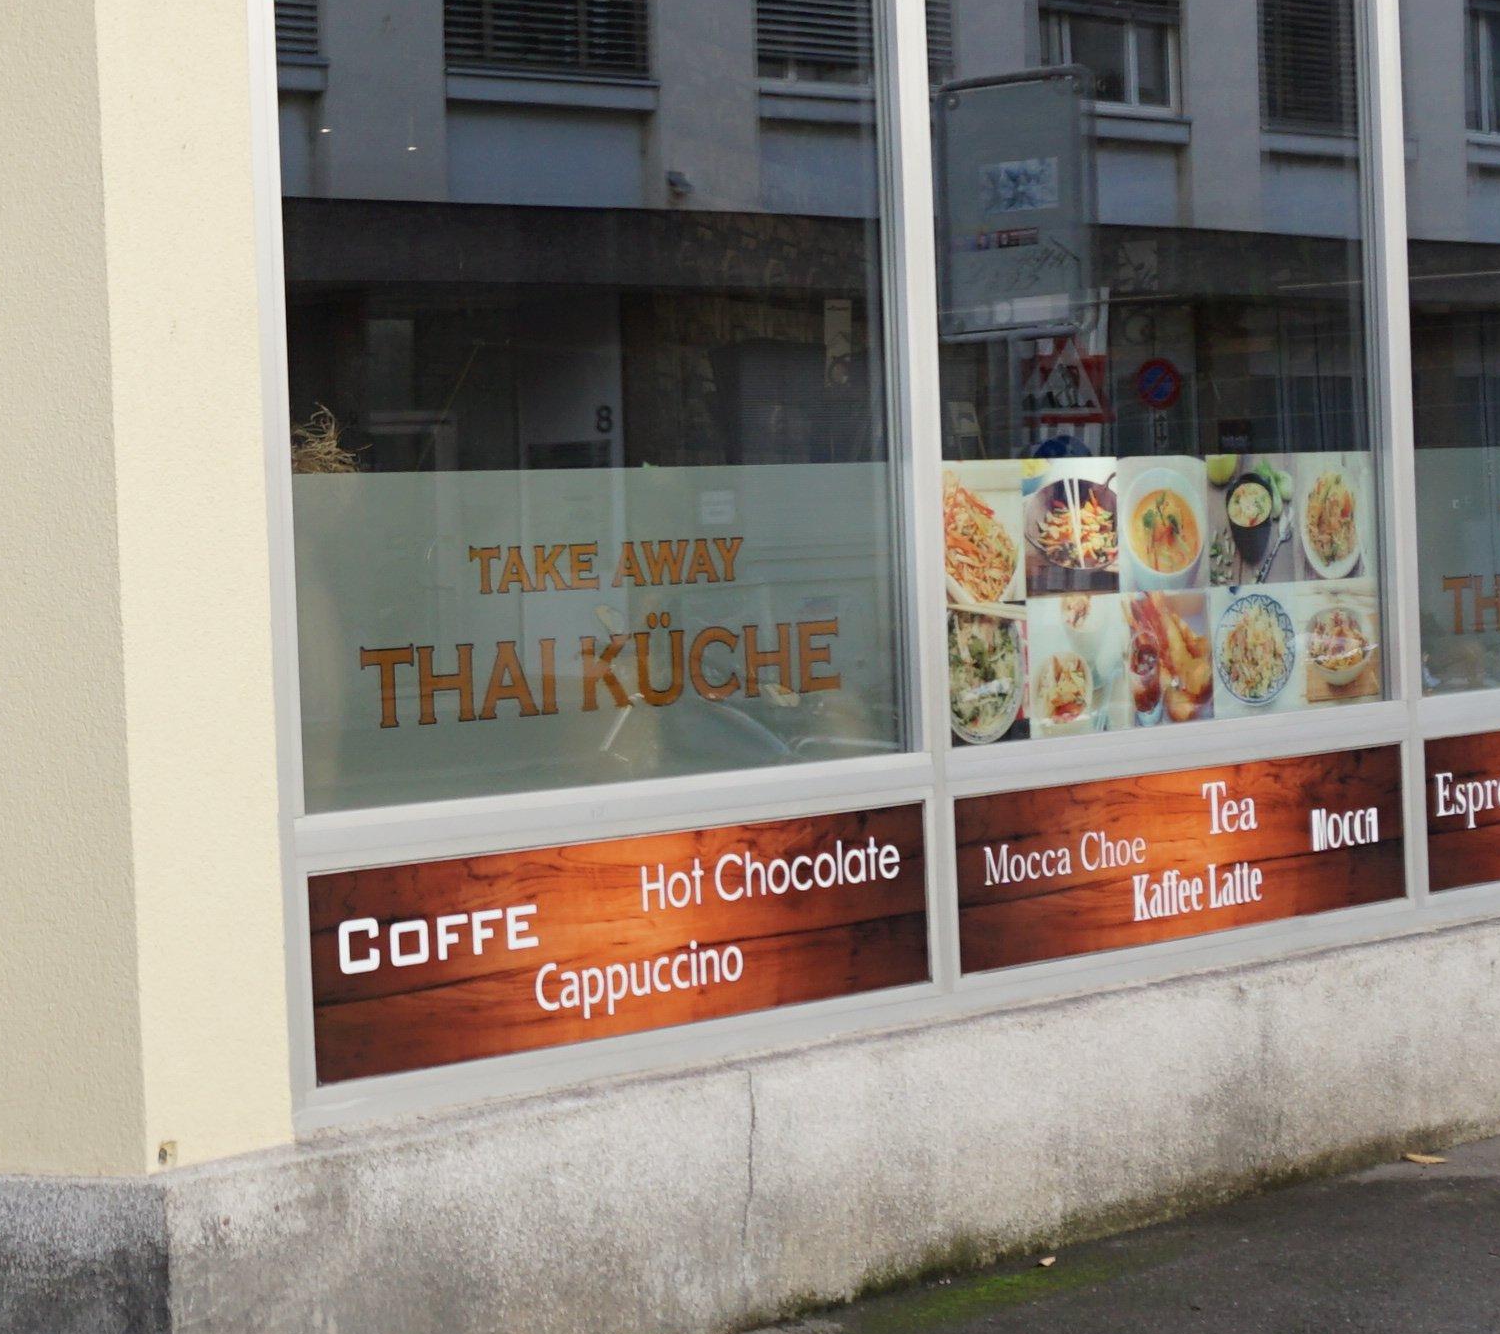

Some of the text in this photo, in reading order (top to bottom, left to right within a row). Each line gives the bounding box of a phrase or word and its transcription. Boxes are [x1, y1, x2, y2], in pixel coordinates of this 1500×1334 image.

[468, 536, 744, 595] TAKE AWAY
[360, 611, 842, 729] THAI KÜCHE
[1202, 780, 1258, 836] Tea
[639, 835, 901, 913] Hot Chocolate
[983, 831, 1147, 886] Mocca Choe
[1132, 861, 1263, 922] Kaffee Latte
[338, 903, 540, 975] COFFE
[534, 940, 745, 1019] Cappuccino
